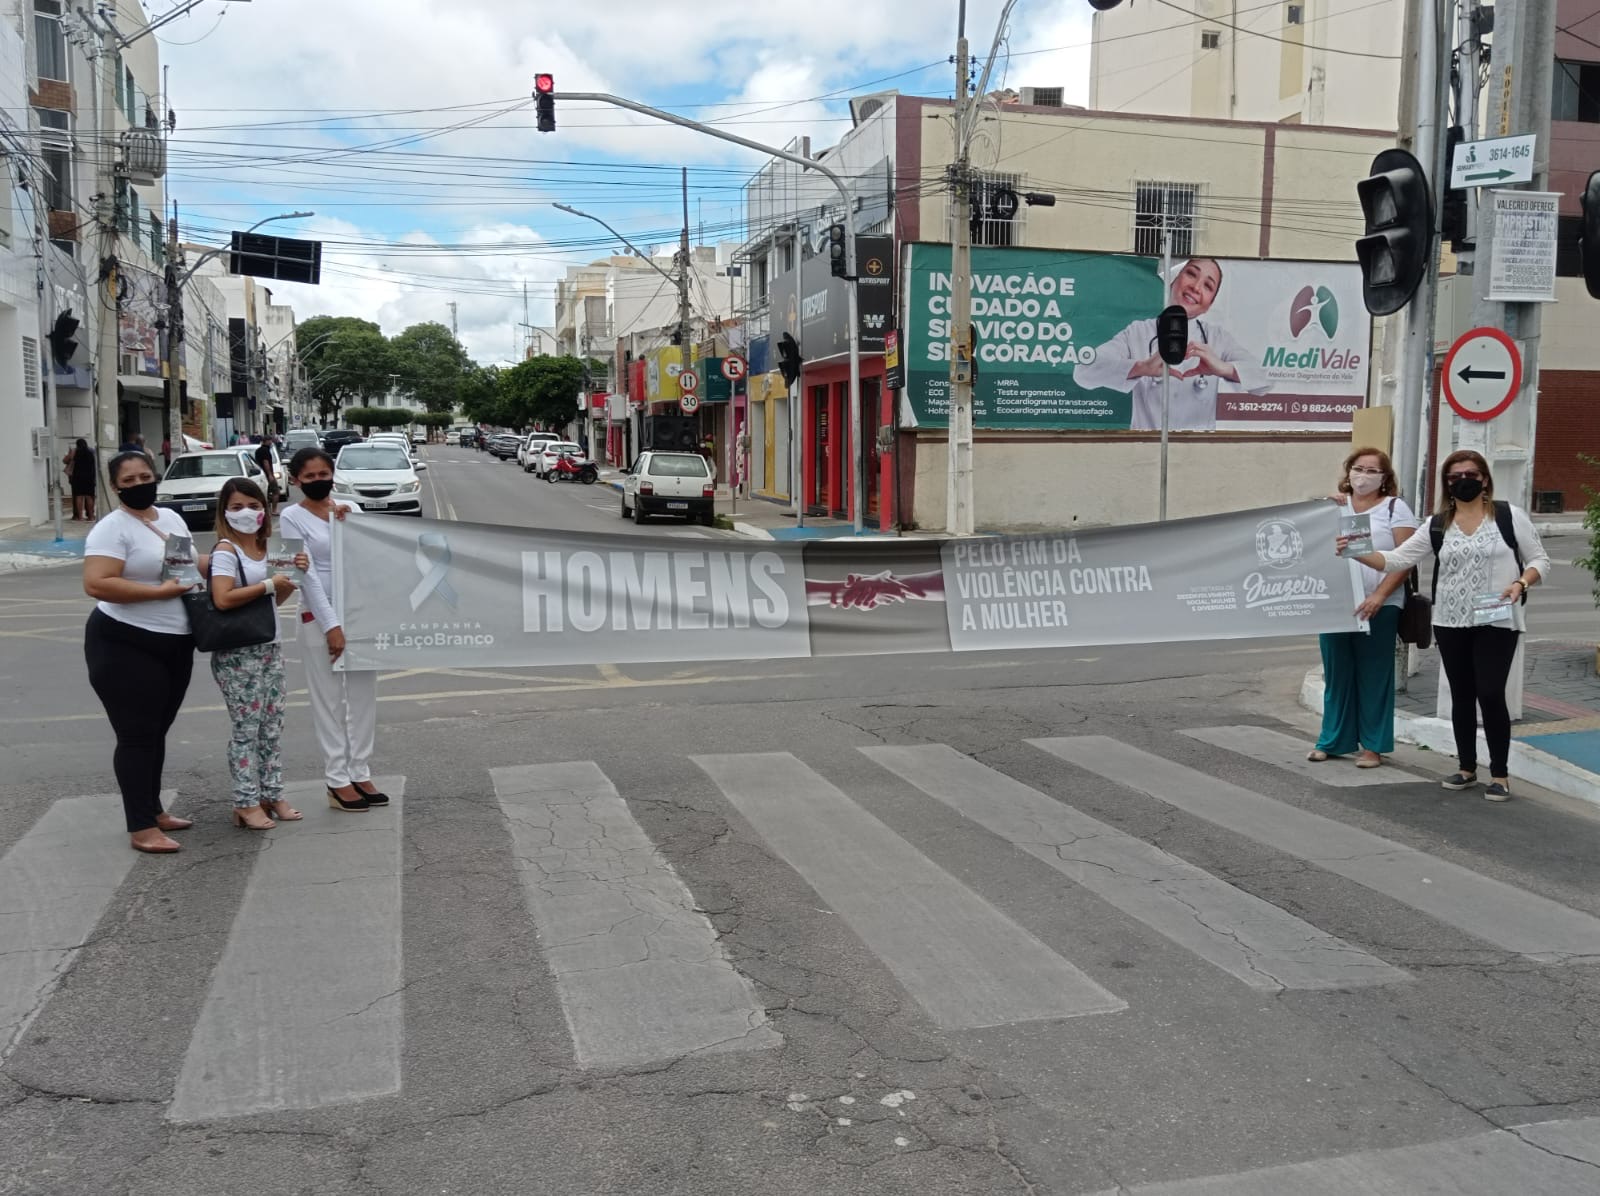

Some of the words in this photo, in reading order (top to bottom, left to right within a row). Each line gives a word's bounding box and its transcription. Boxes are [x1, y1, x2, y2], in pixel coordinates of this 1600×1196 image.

[1489, 145, 1530, 161] 3614-1645
[929, 272, 1057, 298] INVAÇÃO
[1060, 278, 1076, 296] E
[928, 295, 1041, 318] CDADO
[1043, 300, 1062, 318] A
[927, 318, 1035, 343] SVIÇO
[1037, 322, 1073, 342] DO
[980, 342, 1097, 367] CORAÇÃO
[1262, 346, 1361, 370] MediVale
[683, 397, 697, 407] 30
[996, 398, 1058, 408] Ecocardiograma
[996, 407, 1058, 417] Ecocardiograma
[1226, 402, 1237, 411] 74
[1238, 402, 1283, 412] 3612-9274
[1309, 405, 1358, 413] 8824-0490
[954, 543, 1005, 568] PELO
[1010, 540, 1049, 566] FIM
[1052, 538, 1082, 565] DA
[521, 550, 790, 632] HOMENS
[956, 566, 1066, 599] VIOLÊNCIA
[1069, 565, 1153, 595] CONTRA
[1243, 572, 1328, 602] Juazeiro
[399, 621, 482, 631] CAMPANHA
[962, 604, 977, 631] A
[980, 600, 1069, 630] MULHER
[374, 632, 495, 651] #LaçoBranco
